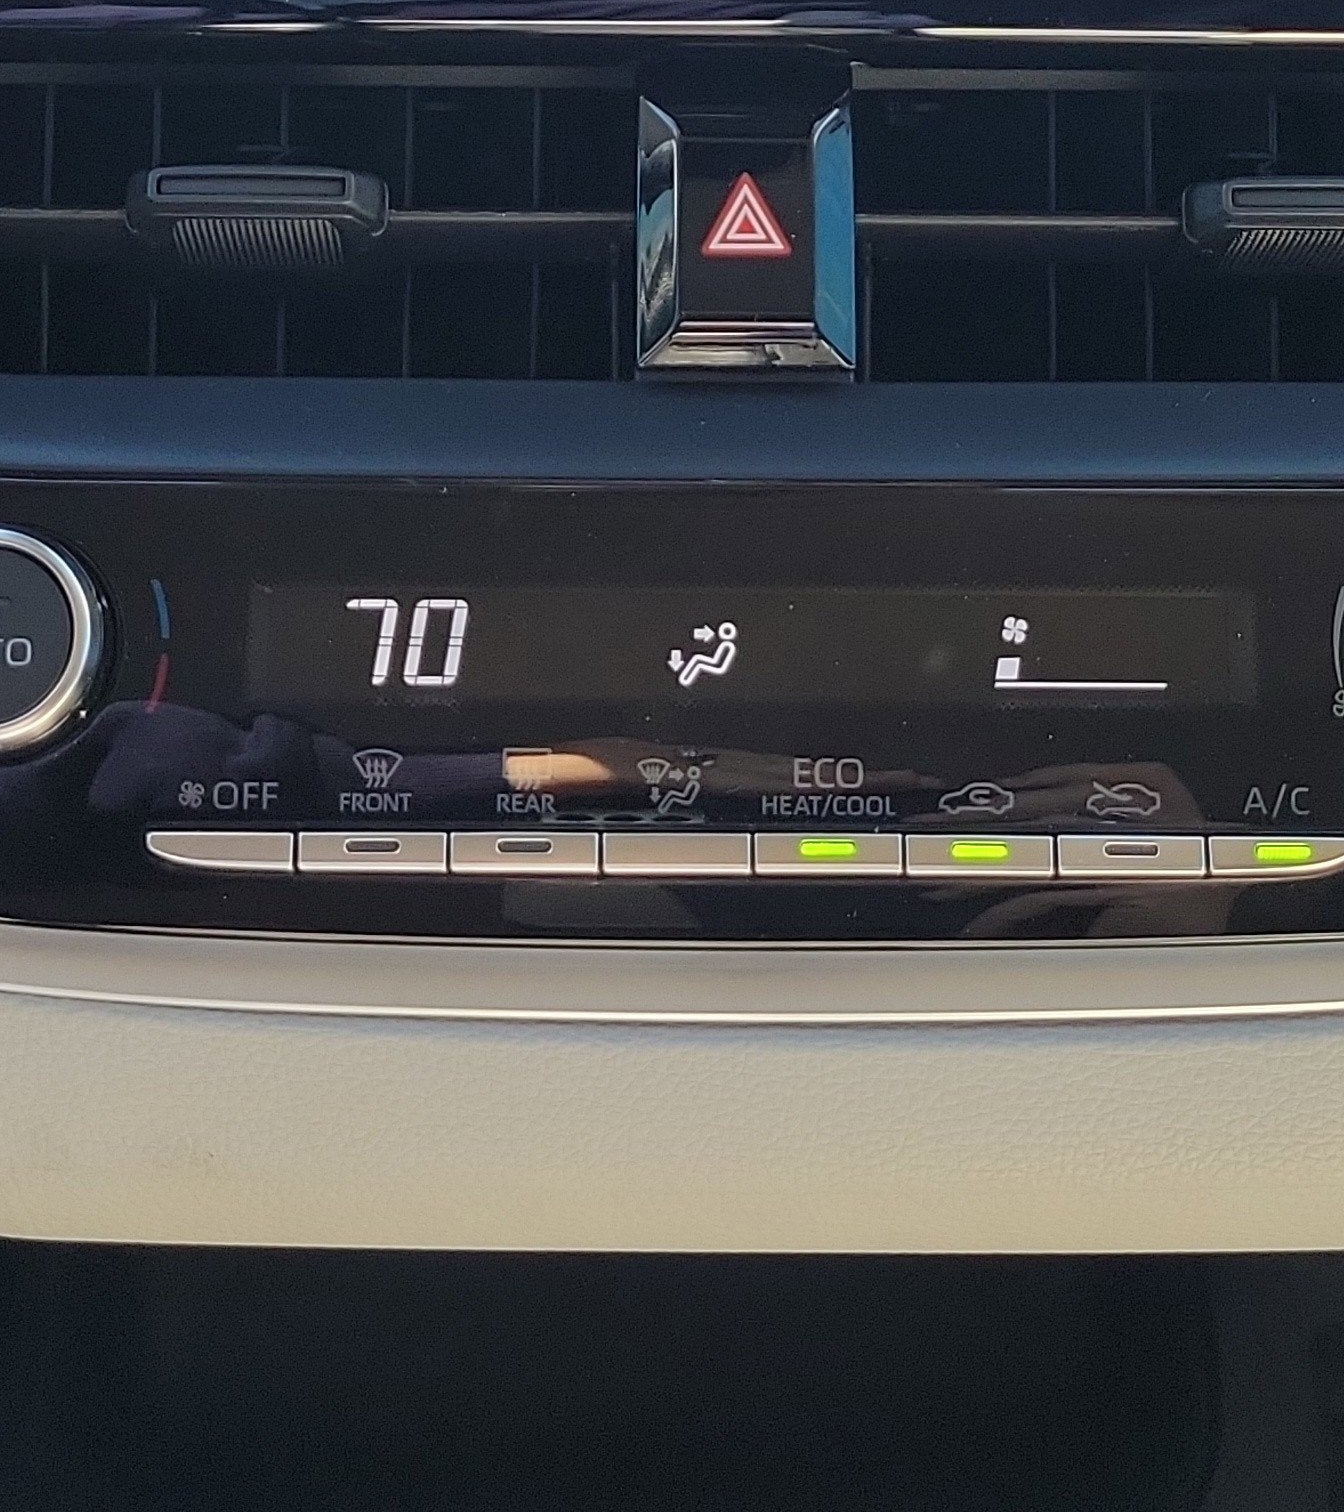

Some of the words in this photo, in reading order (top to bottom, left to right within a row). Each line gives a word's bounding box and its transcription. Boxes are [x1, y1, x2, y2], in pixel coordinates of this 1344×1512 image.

[346, 598, 469, 686] 70
[793, 758, 864, 789] ECO
[212, 781, 279, 810] OFF
[339, 792, 412, 812] FRONT
[497, 793, 555, 813] REAR
[761, 794, 896, 817] HEAT/COOL
[1243, 783, 1310, 818] A/C
